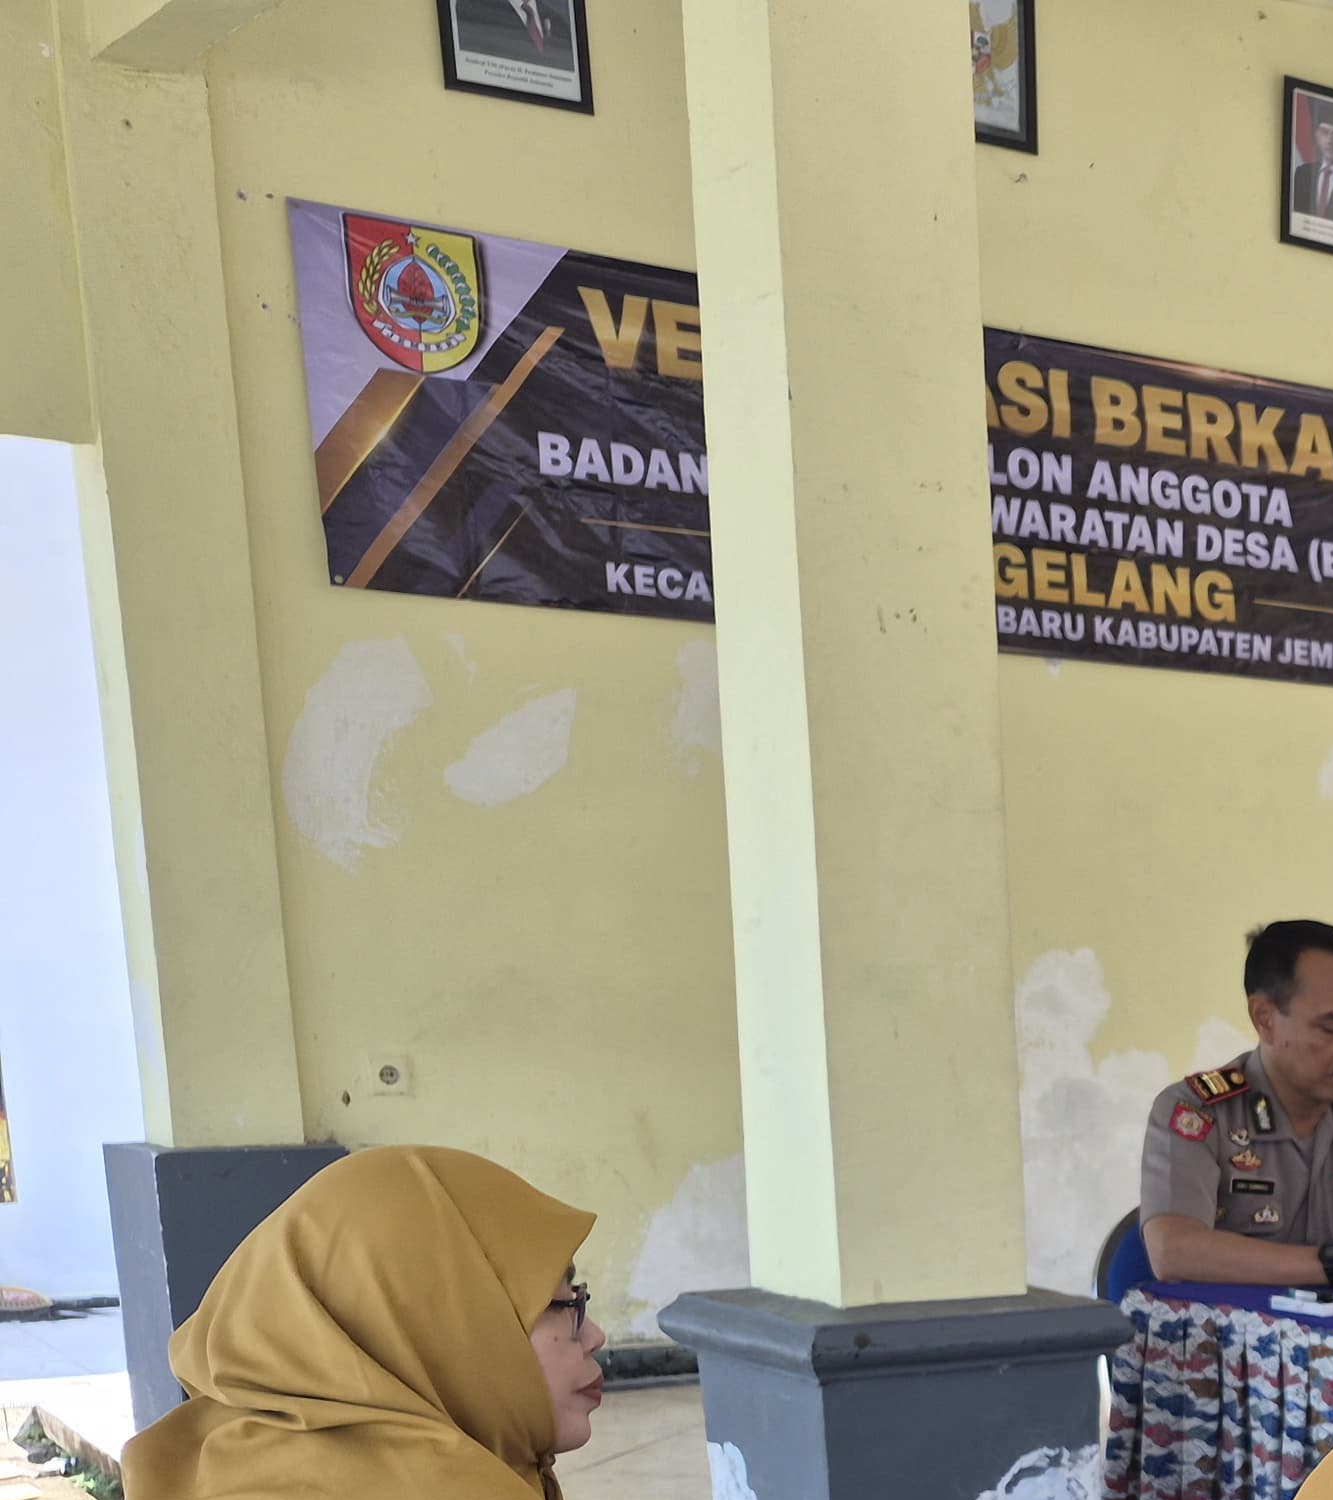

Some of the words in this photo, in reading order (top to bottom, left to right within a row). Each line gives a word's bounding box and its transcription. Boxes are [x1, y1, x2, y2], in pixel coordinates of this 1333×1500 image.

[537, 431, 708, 496] BADAN
[1198, 523, 1298, 573] DESA
[1087, 460, 1293, 527] ANGGOTA
[605, 561, 712, 602] KECA
[997, 604, 1085, 641] BARU
[1095, 615, 1270, 662] KABUPATEN
[993, 542, 1235, 622] GELANG
